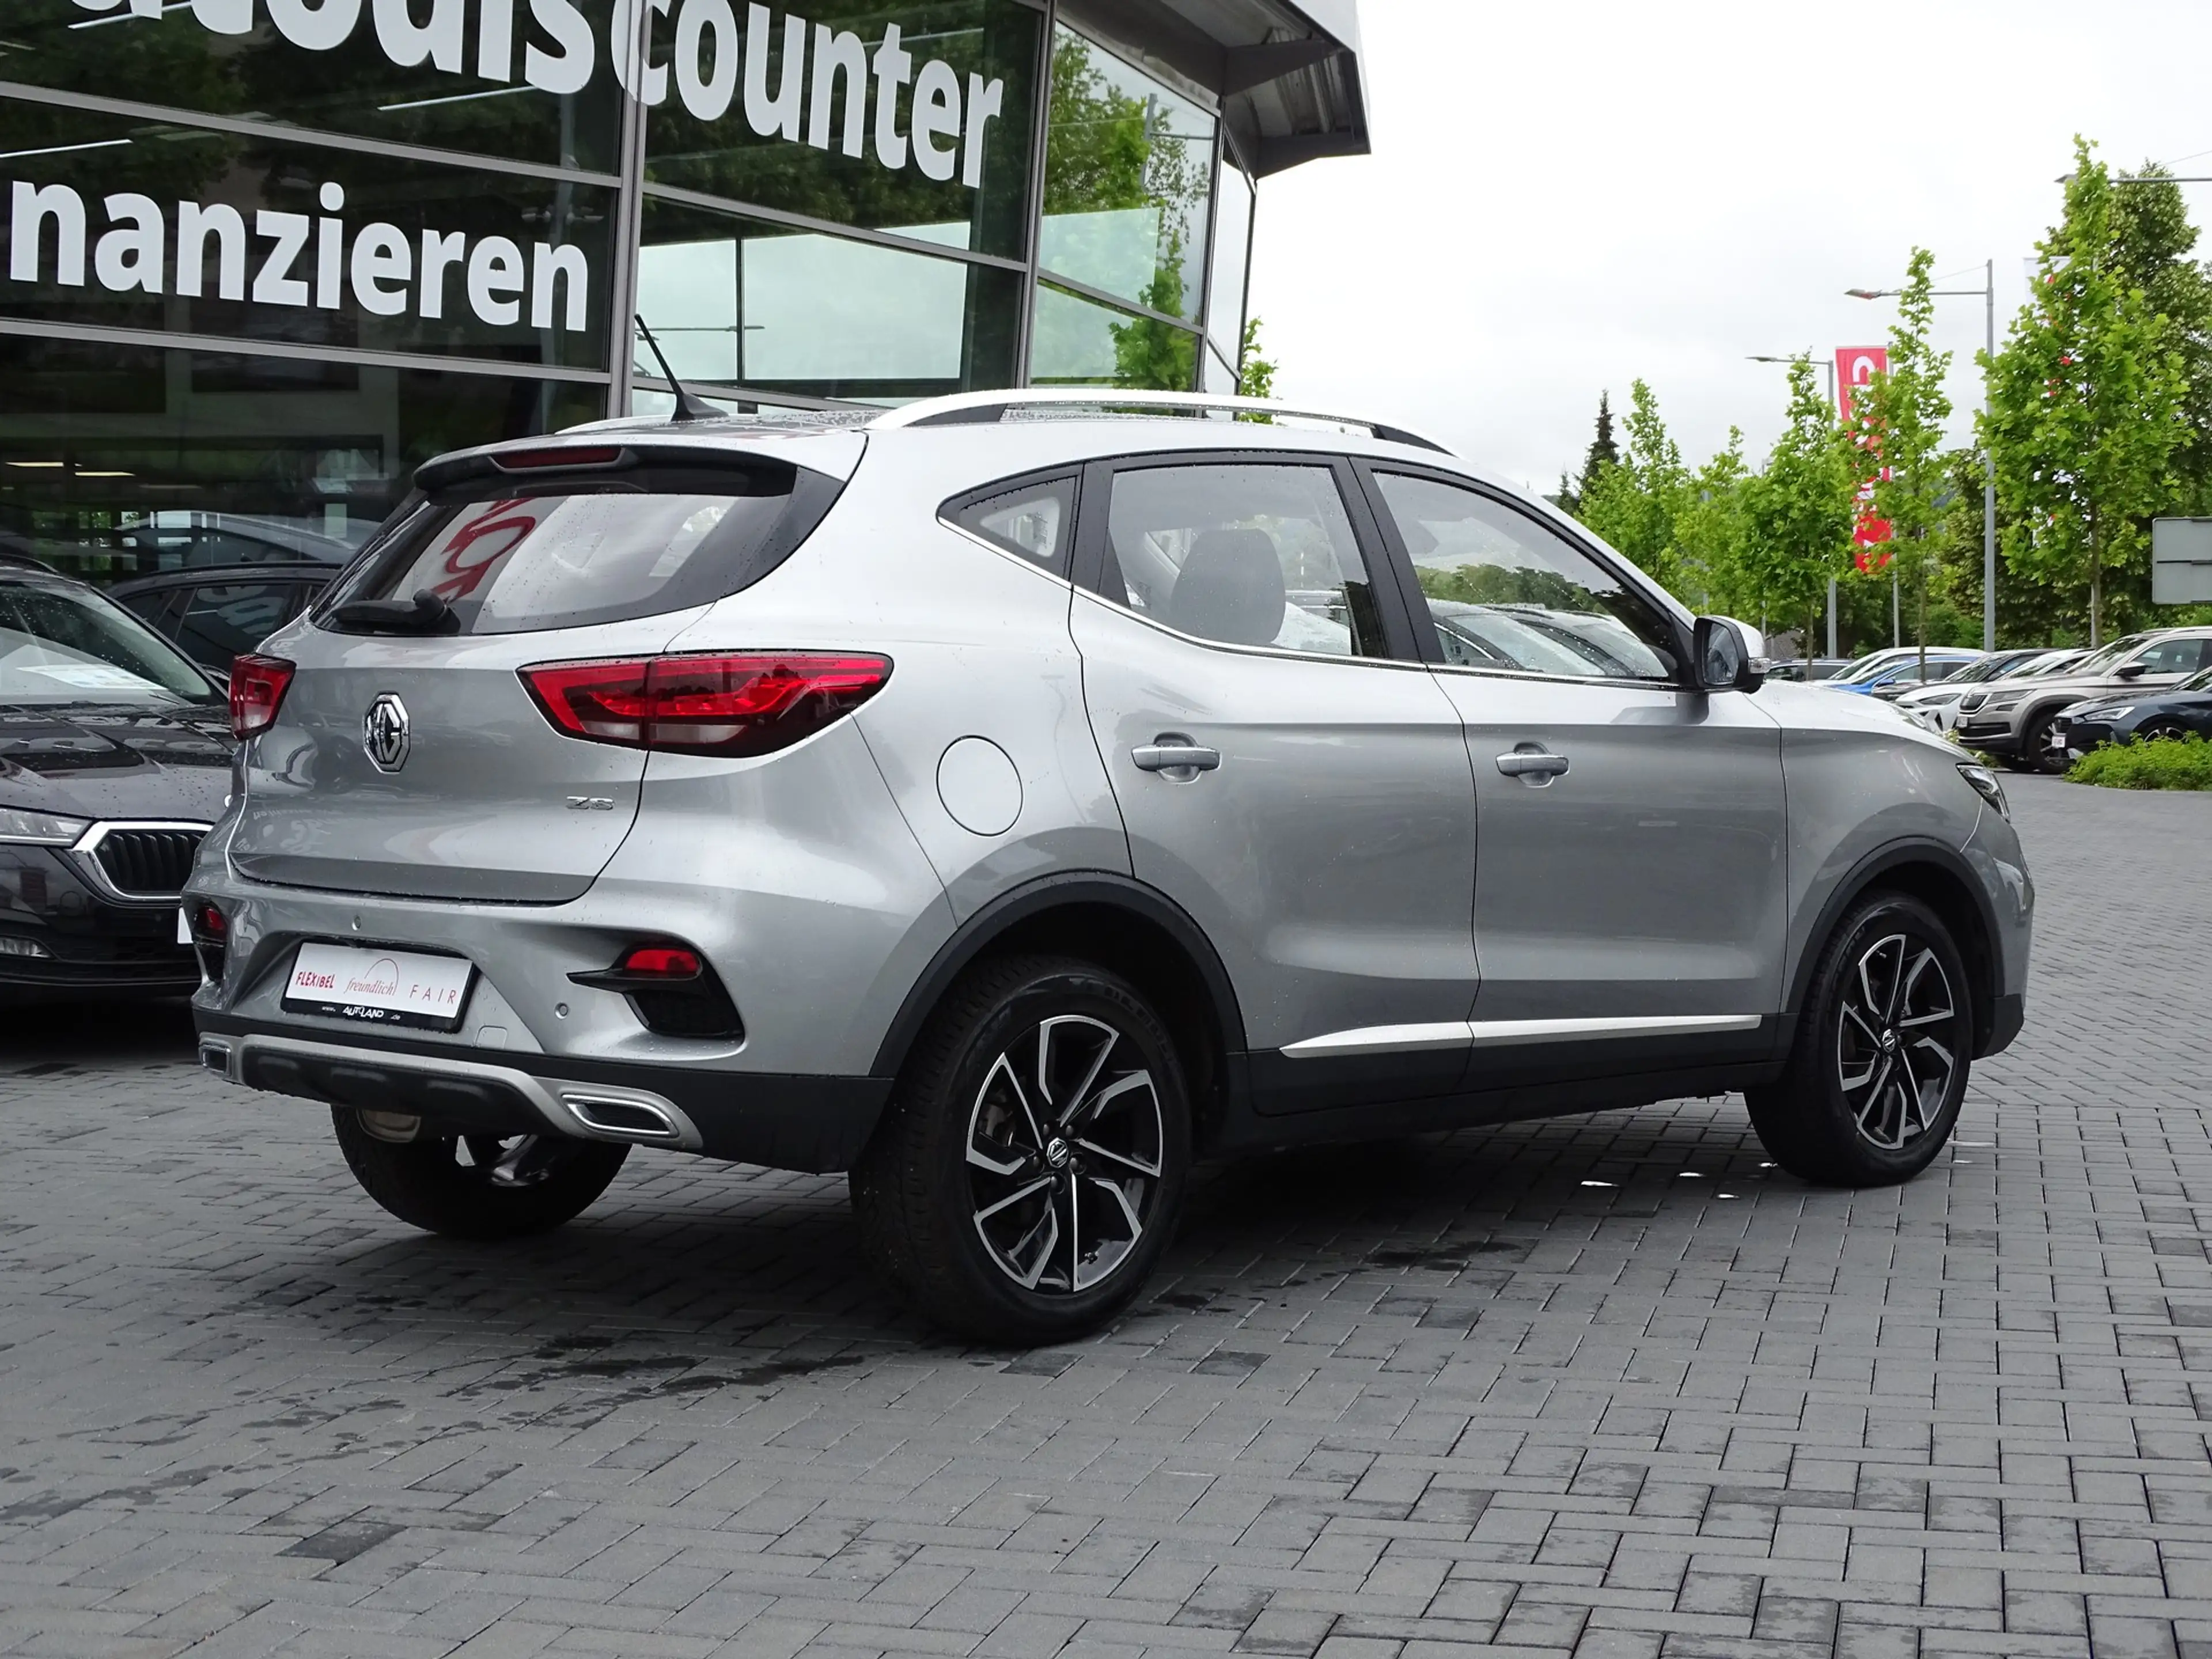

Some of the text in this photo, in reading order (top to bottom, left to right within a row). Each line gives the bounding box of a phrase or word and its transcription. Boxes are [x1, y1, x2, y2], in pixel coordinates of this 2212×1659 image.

[10, 180, 588, 332] nanzieren
[295, 971, 336, 988] FLEXIBEL
[344, 978, 395, 995] freundlich
